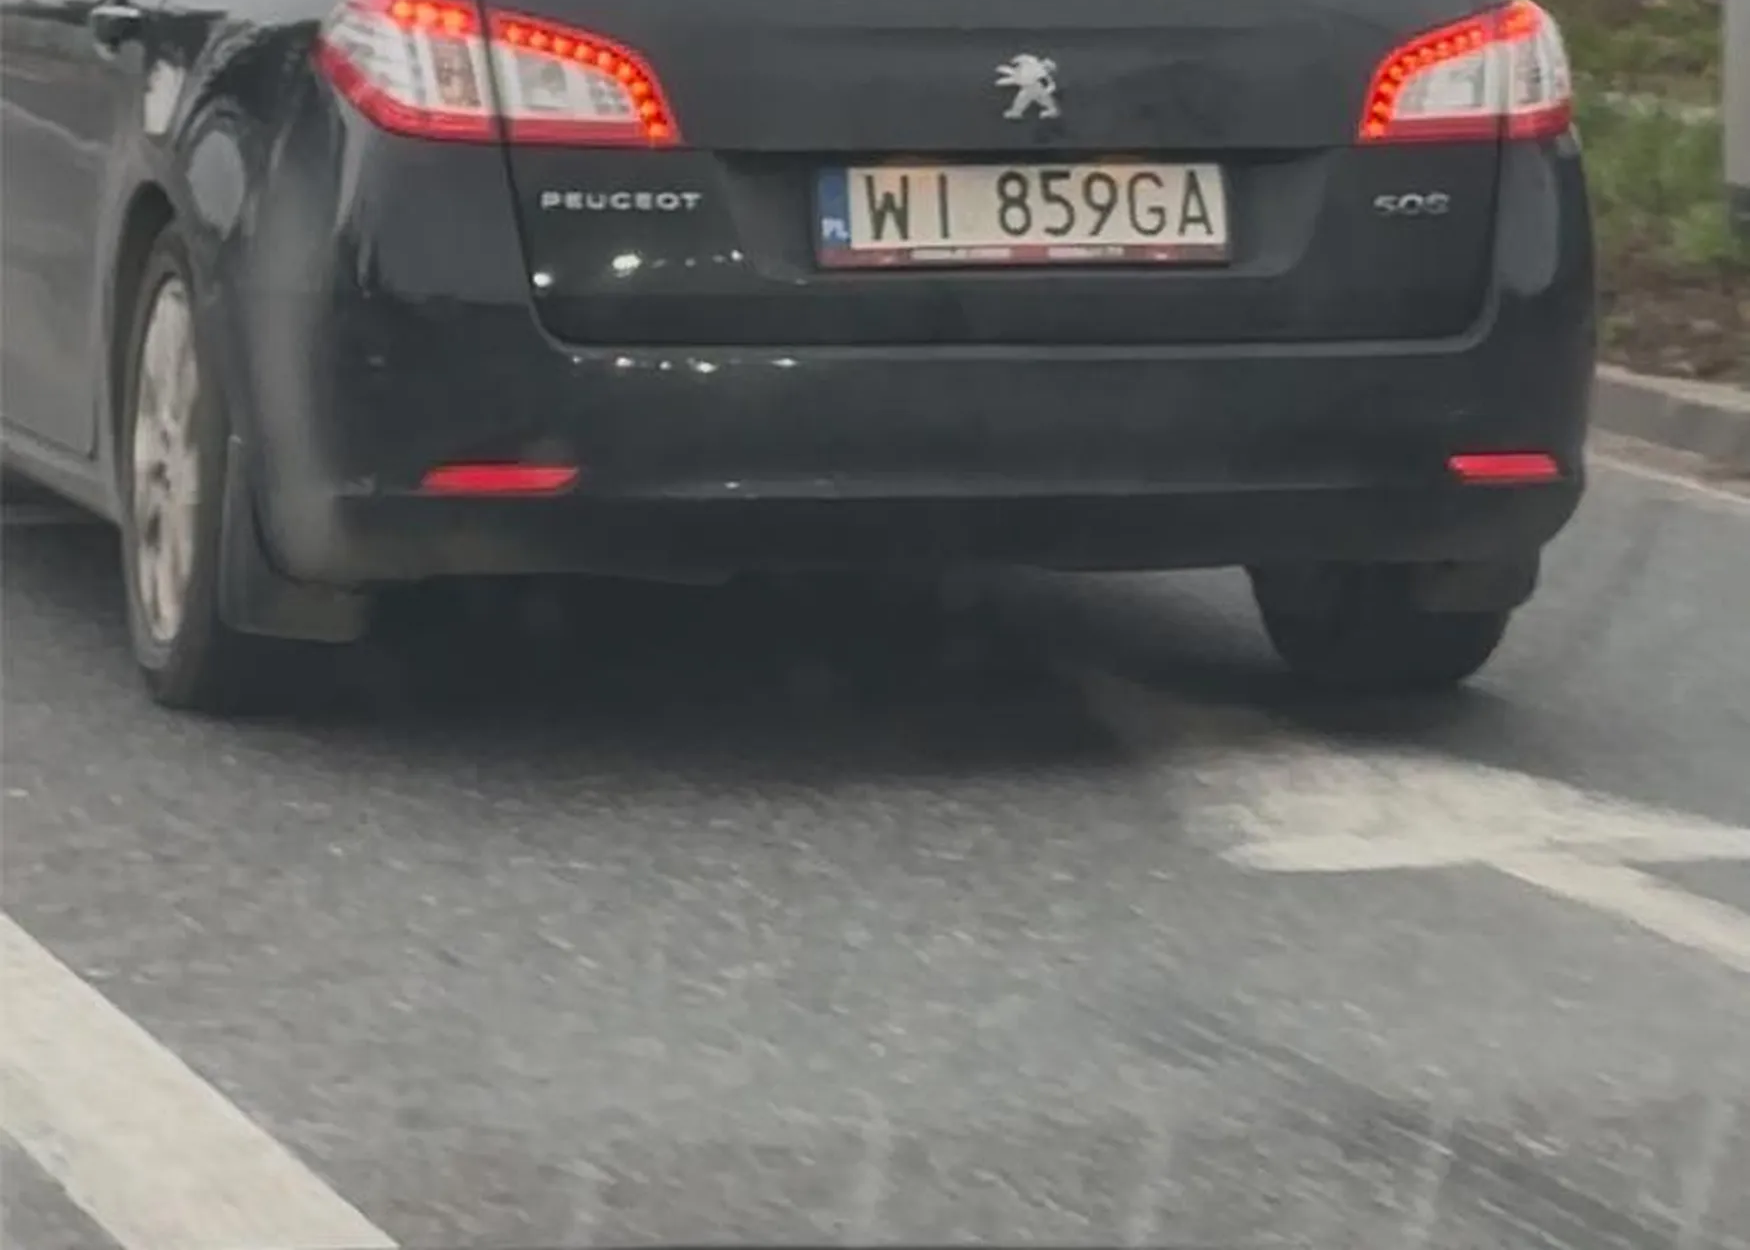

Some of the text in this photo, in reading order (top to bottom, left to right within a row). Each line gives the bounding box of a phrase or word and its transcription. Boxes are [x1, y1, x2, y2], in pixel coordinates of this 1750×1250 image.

[540, 190, 703, 211] PEUGEOT
[863, 169, 1216, 241] WI 859GA
